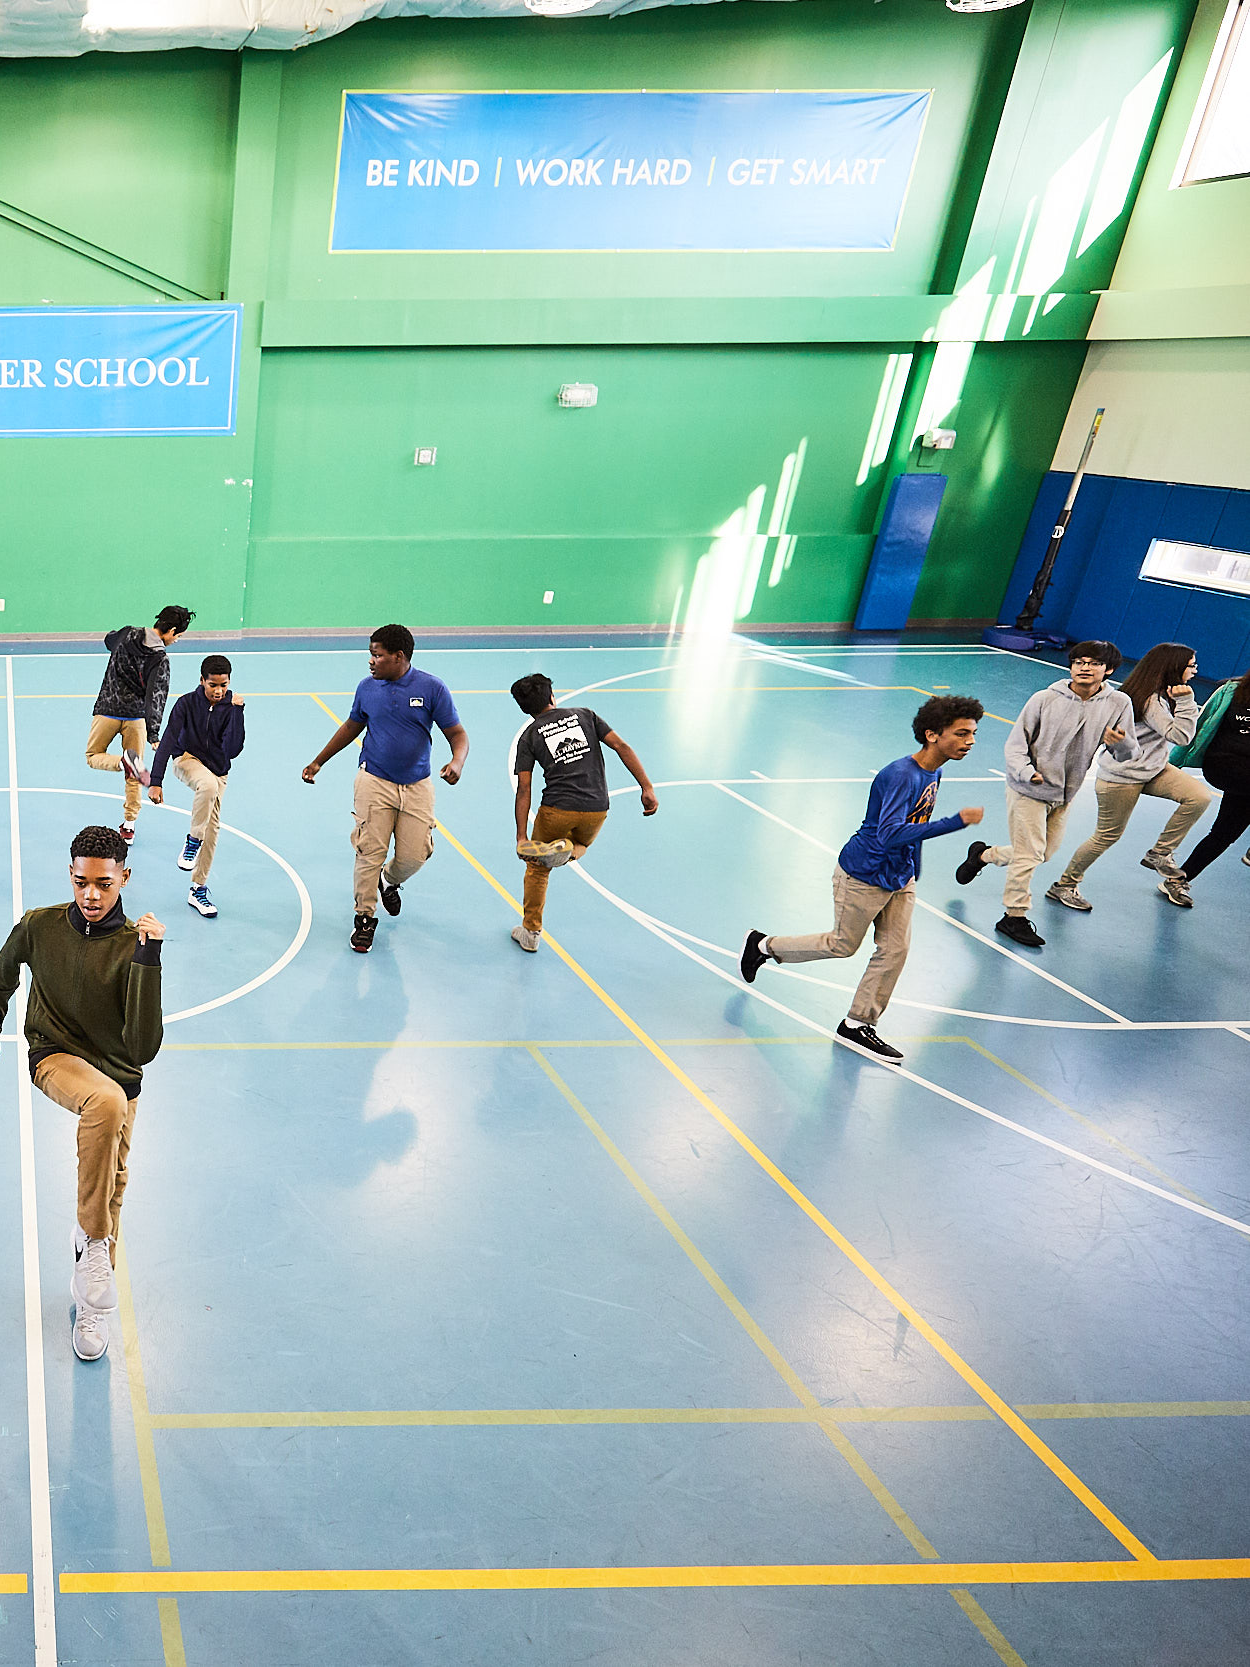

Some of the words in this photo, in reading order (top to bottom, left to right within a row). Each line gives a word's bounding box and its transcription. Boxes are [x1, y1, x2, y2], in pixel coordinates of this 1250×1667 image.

[366, 159, 400, 187] BE
[407, 159, 480, 187] KIND
[516, 158, 605, 187] WORK
[611, 158, 692, 186] HARD
[727, 158, 784, 186] GET
[789, 158, 886, 186] SMART
[54, 357, 210, 388] SCHOOL
